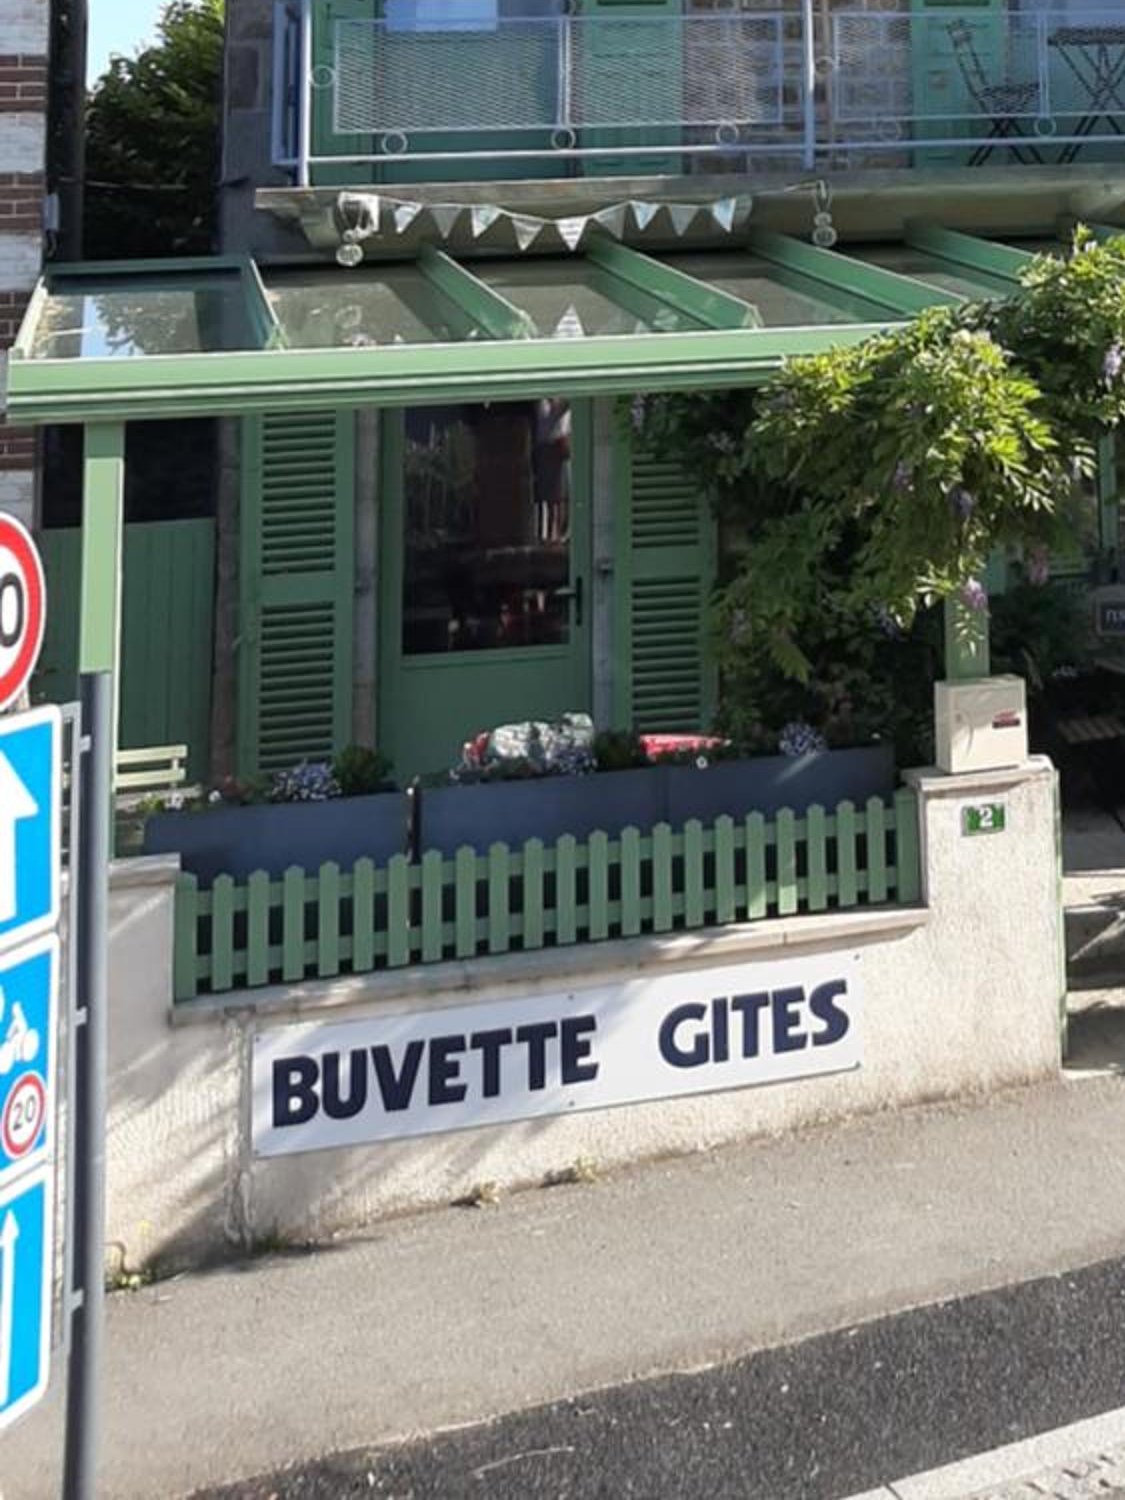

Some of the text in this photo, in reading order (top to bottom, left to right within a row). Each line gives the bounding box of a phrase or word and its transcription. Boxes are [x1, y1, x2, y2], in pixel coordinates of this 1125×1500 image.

[979, 807, 994, 828] 2
[272, 979, 851, 1127] BUVETTE GITES
[13, 1094, 37, 1131] 20
